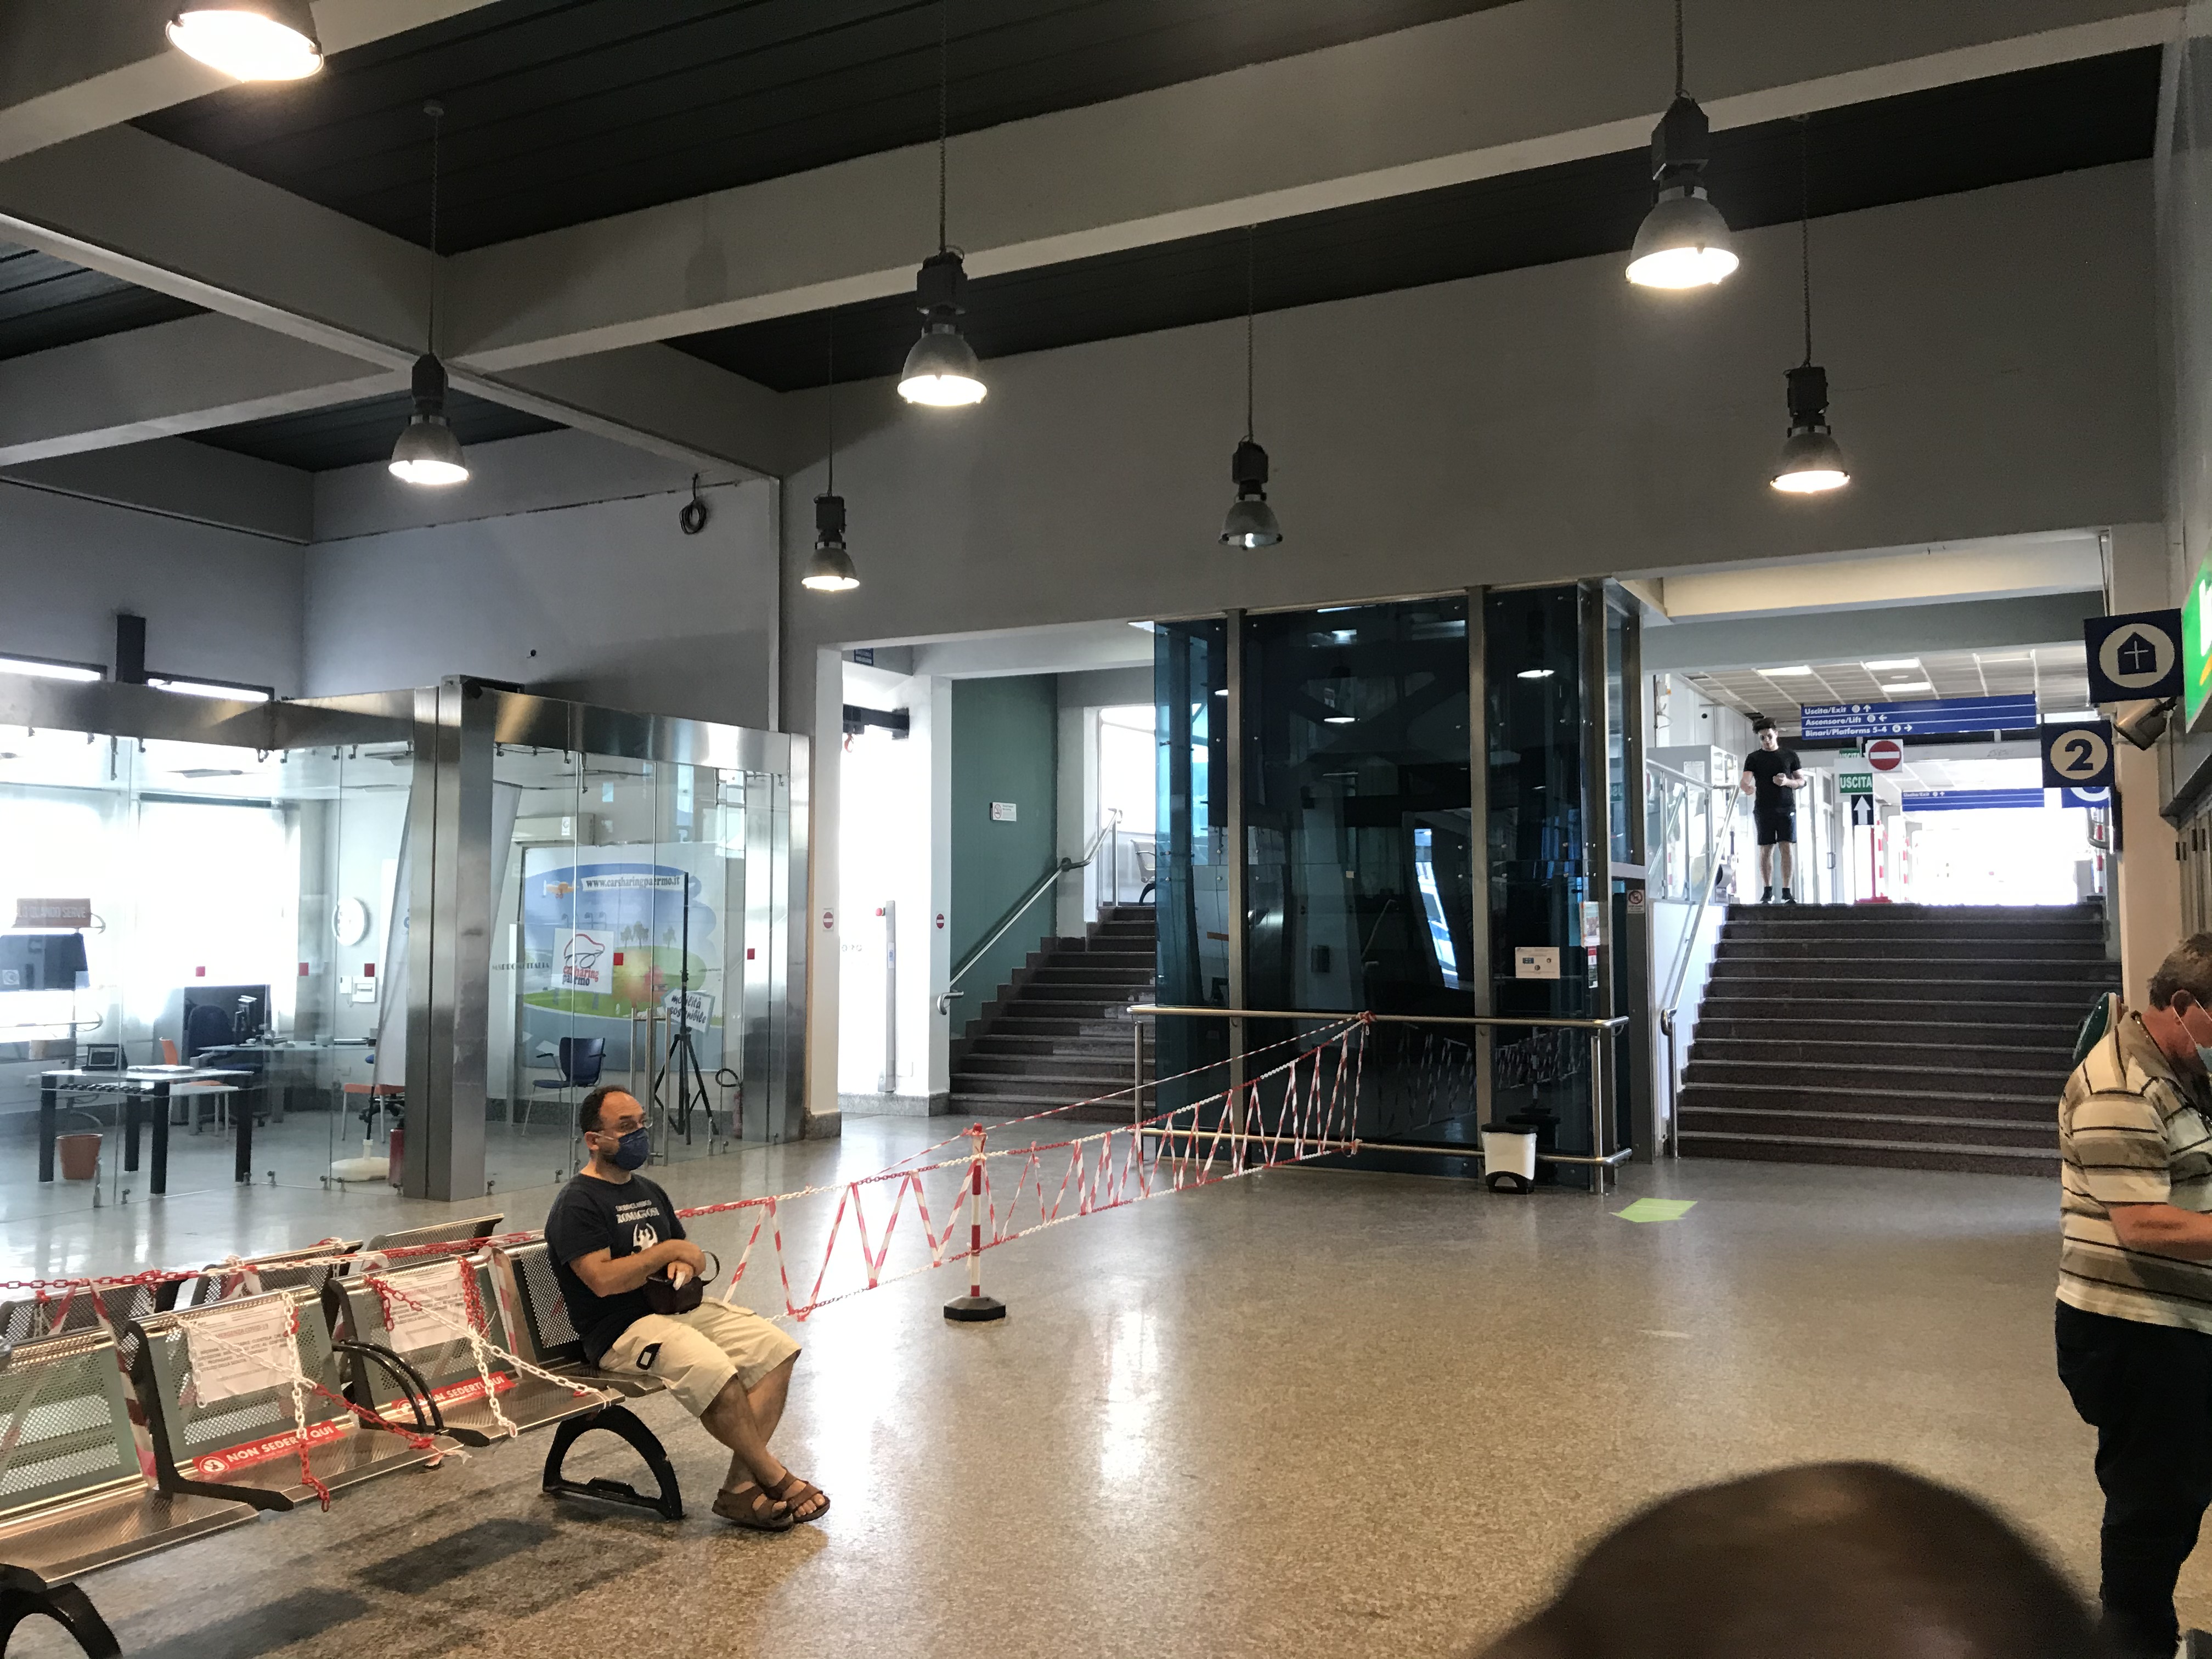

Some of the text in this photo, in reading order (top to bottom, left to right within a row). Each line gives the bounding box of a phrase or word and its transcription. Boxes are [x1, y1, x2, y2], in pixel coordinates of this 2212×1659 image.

[1804, 706, 1847, 715] Uscita/Exit
[1805, 716, 1861, 726] Ascensore/Lift
[1805, 727, 1871, 737] Binari/Platforms
[2064, 738, 2094, 771] 2
[1840, 776, 1872, 788] USCITA
[586, 876, 680, 889] www.carsharingpaermo.it
[562, 974, 590, 986] palrmo
[671, 995, 701, 1009] moilità
[670, 1006, 707, 1024] sosnibile
[225, 1447, 260, 1463] NON
[261, 1430, 309, 1453] SEDER
[309, 1425, 334, 1438] QUI
